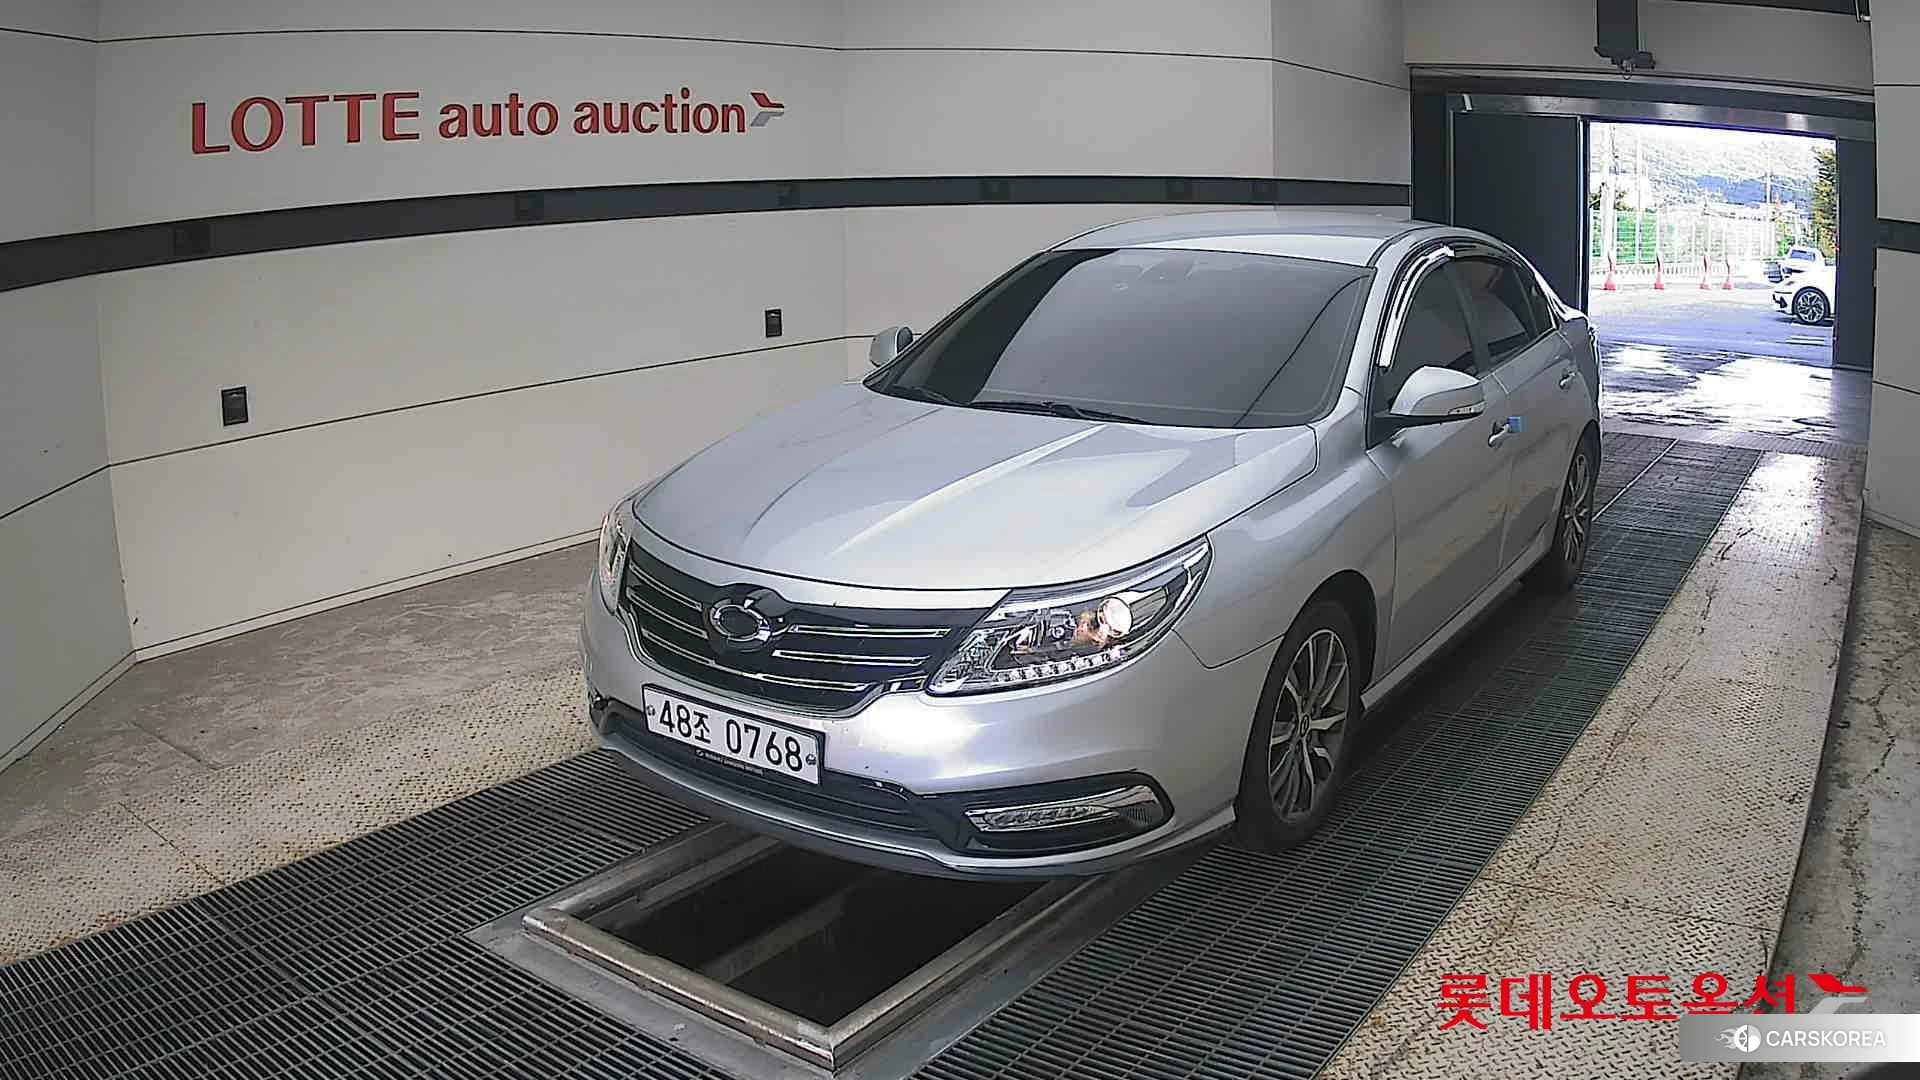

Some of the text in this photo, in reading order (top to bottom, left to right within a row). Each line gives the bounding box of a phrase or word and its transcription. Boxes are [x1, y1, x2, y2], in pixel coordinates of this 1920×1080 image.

[191, 87, 747, 155] LOTTE auto auction
[659, 700, 711, 744] 48조
[725, 718, 803, 772] 0768
